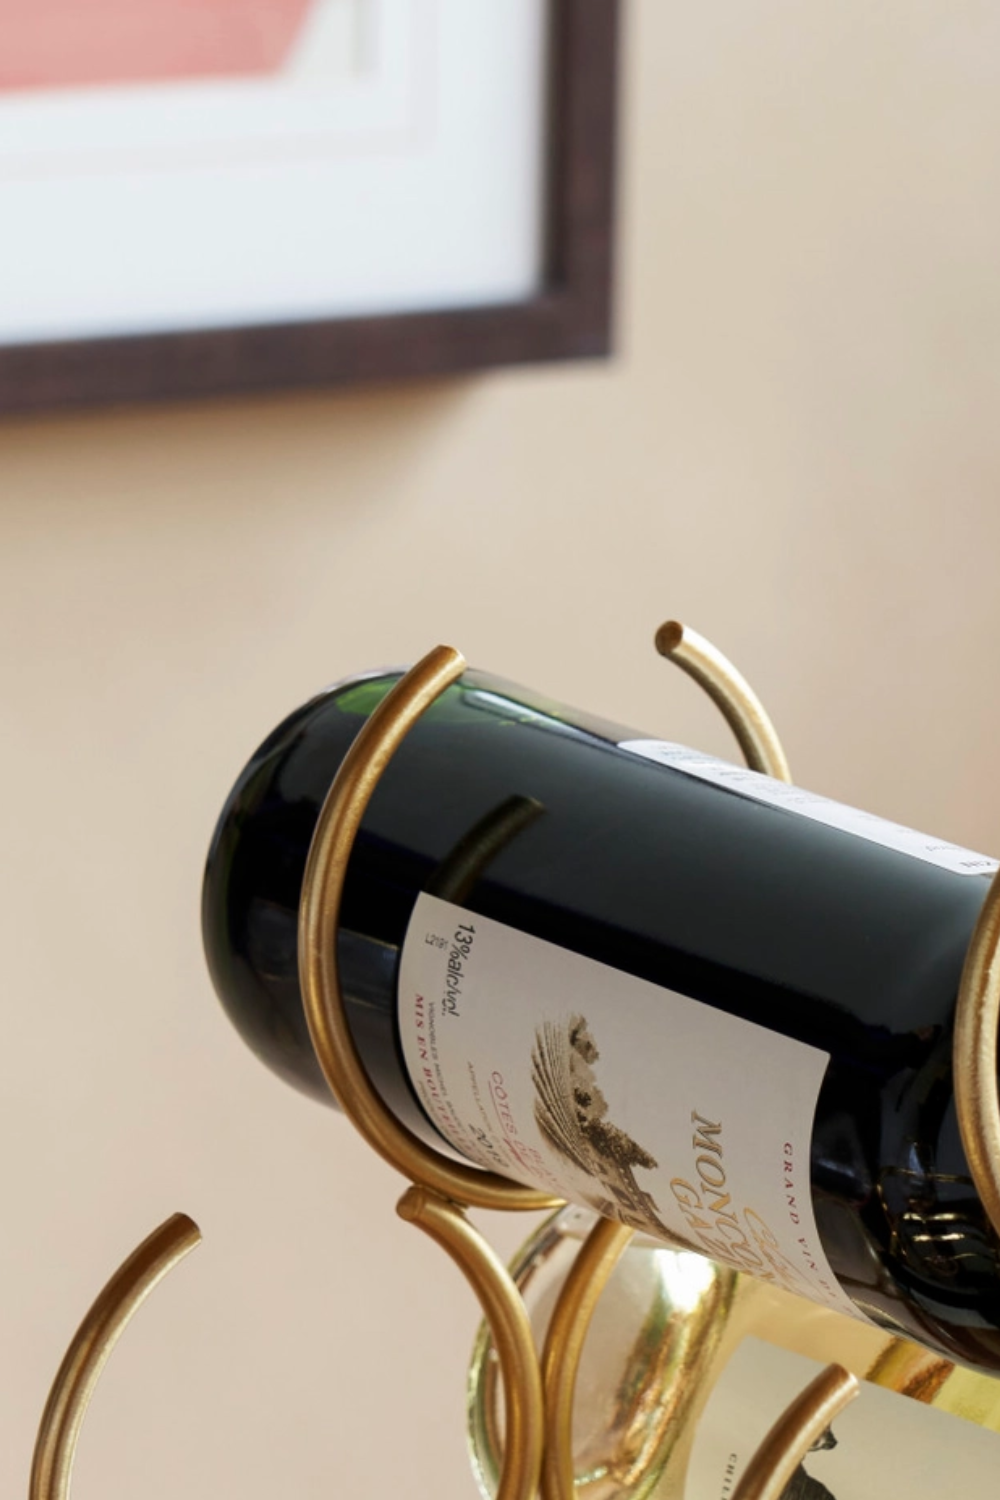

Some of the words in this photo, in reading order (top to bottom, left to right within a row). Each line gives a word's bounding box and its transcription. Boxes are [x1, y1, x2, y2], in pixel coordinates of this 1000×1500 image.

[414, 993, 424, 1029] MIS
[417, 1035, 428, 1061] EN
[783, 1142, 800, 1226] GRAND
[798, 1237, 818, 1271] VIN
